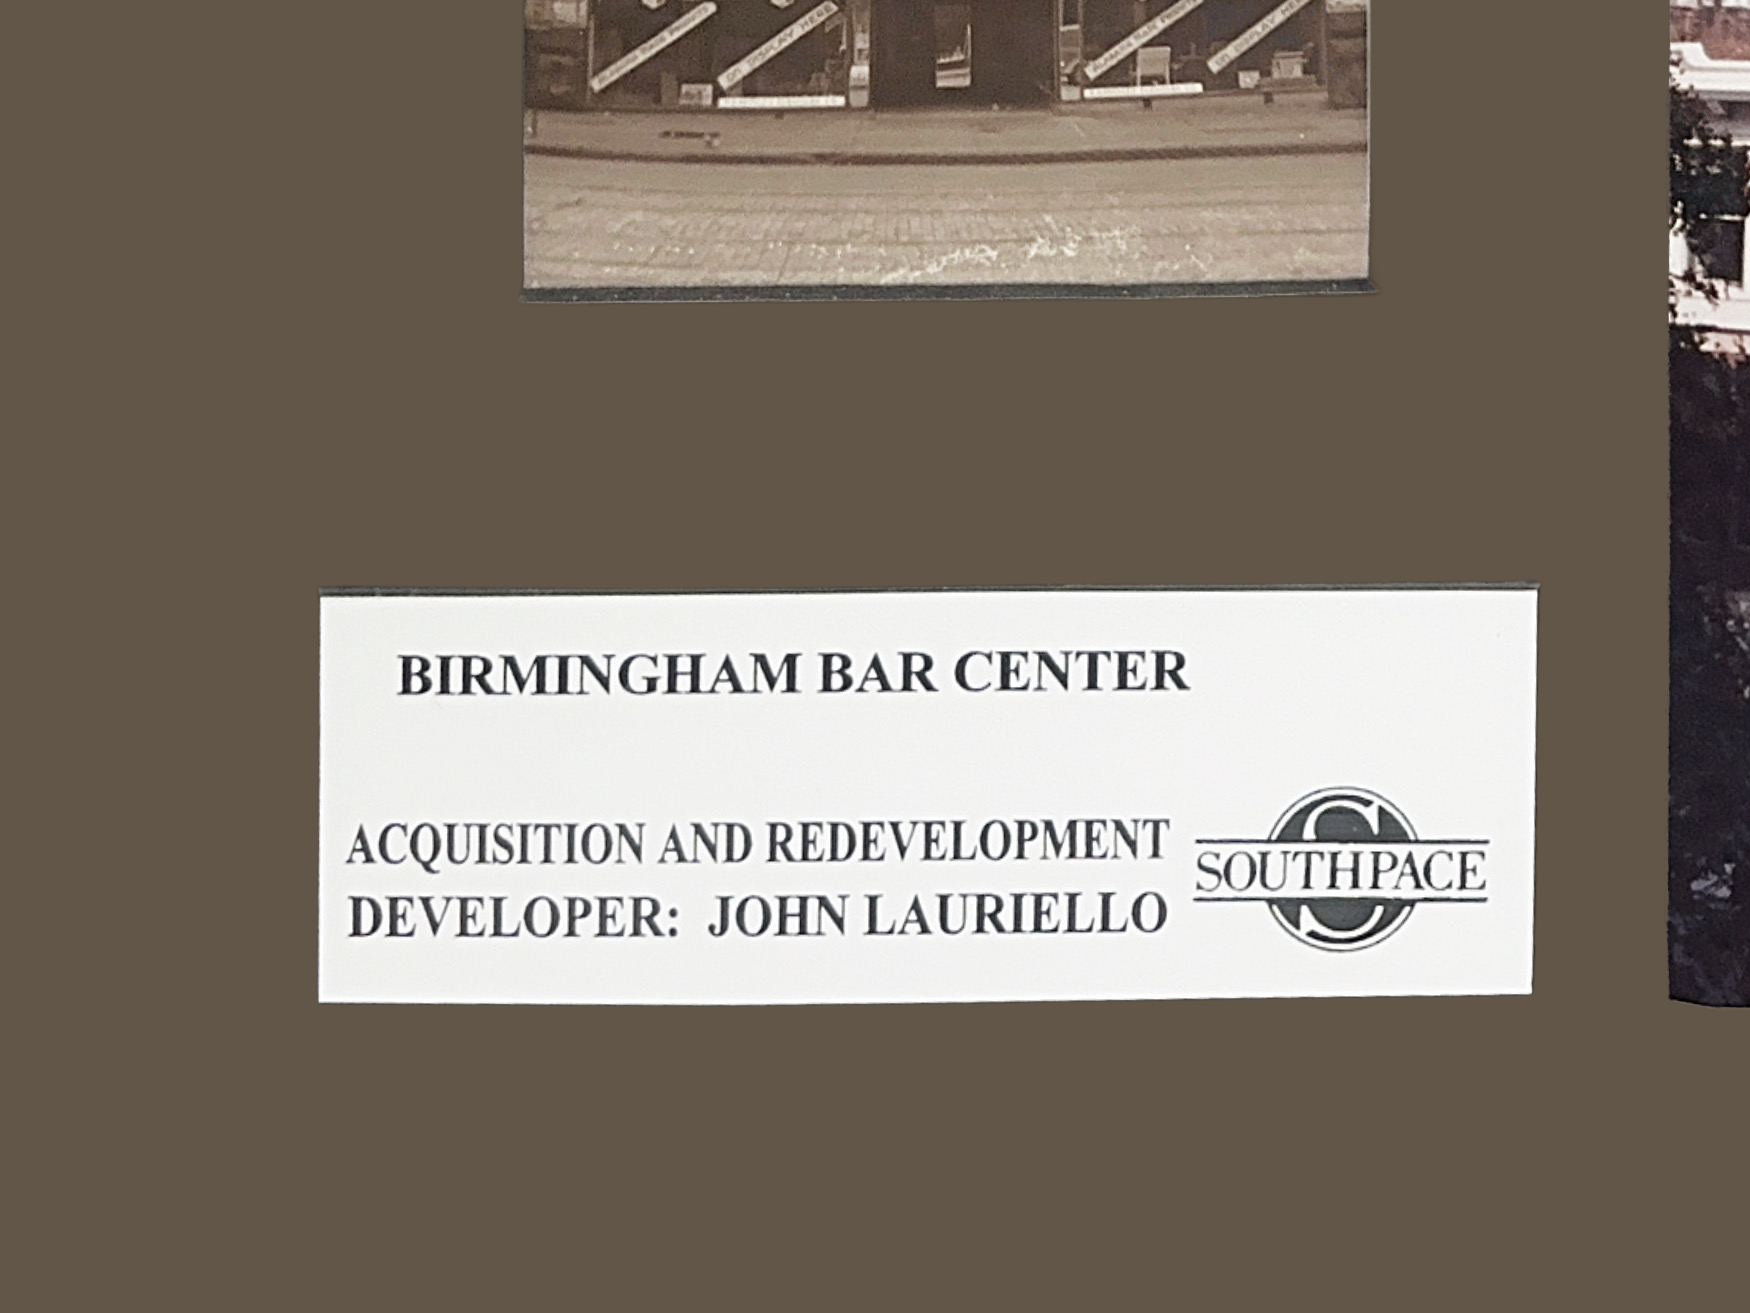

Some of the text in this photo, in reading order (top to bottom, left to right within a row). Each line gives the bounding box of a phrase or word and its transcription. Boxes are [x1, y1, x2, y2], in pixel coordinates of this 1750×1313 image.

[398, 650, 1190, 696] BIRMINGHAM BAR CENTER
[346, 819, 1170, 874] ACQUISITION AND REDEVELOPMENT
[1196, 850, 1486, 892] SOUTHPACE
[348, 892, 1167, 938] DEVELOPER: JOHN LAURIELLO
